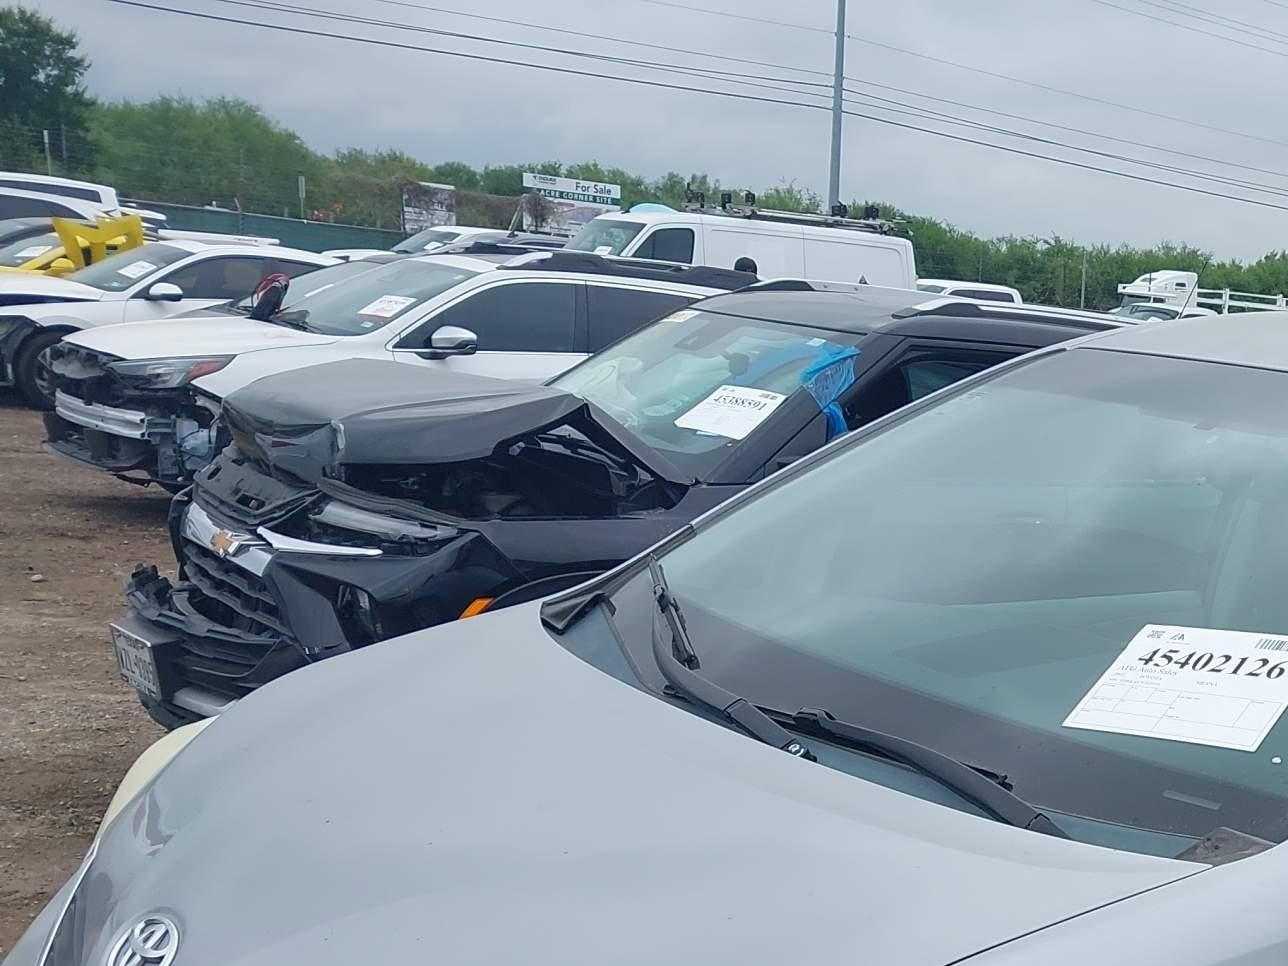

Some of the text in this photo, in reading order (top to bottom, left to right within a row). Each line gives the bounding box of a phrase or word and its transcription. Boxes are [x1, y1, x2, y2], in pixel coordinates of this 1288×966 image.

[575, 182, 612, 195] For Sale
[562, 192, 594, 202] CORNER
[595, 197, 612, 205] SITE
